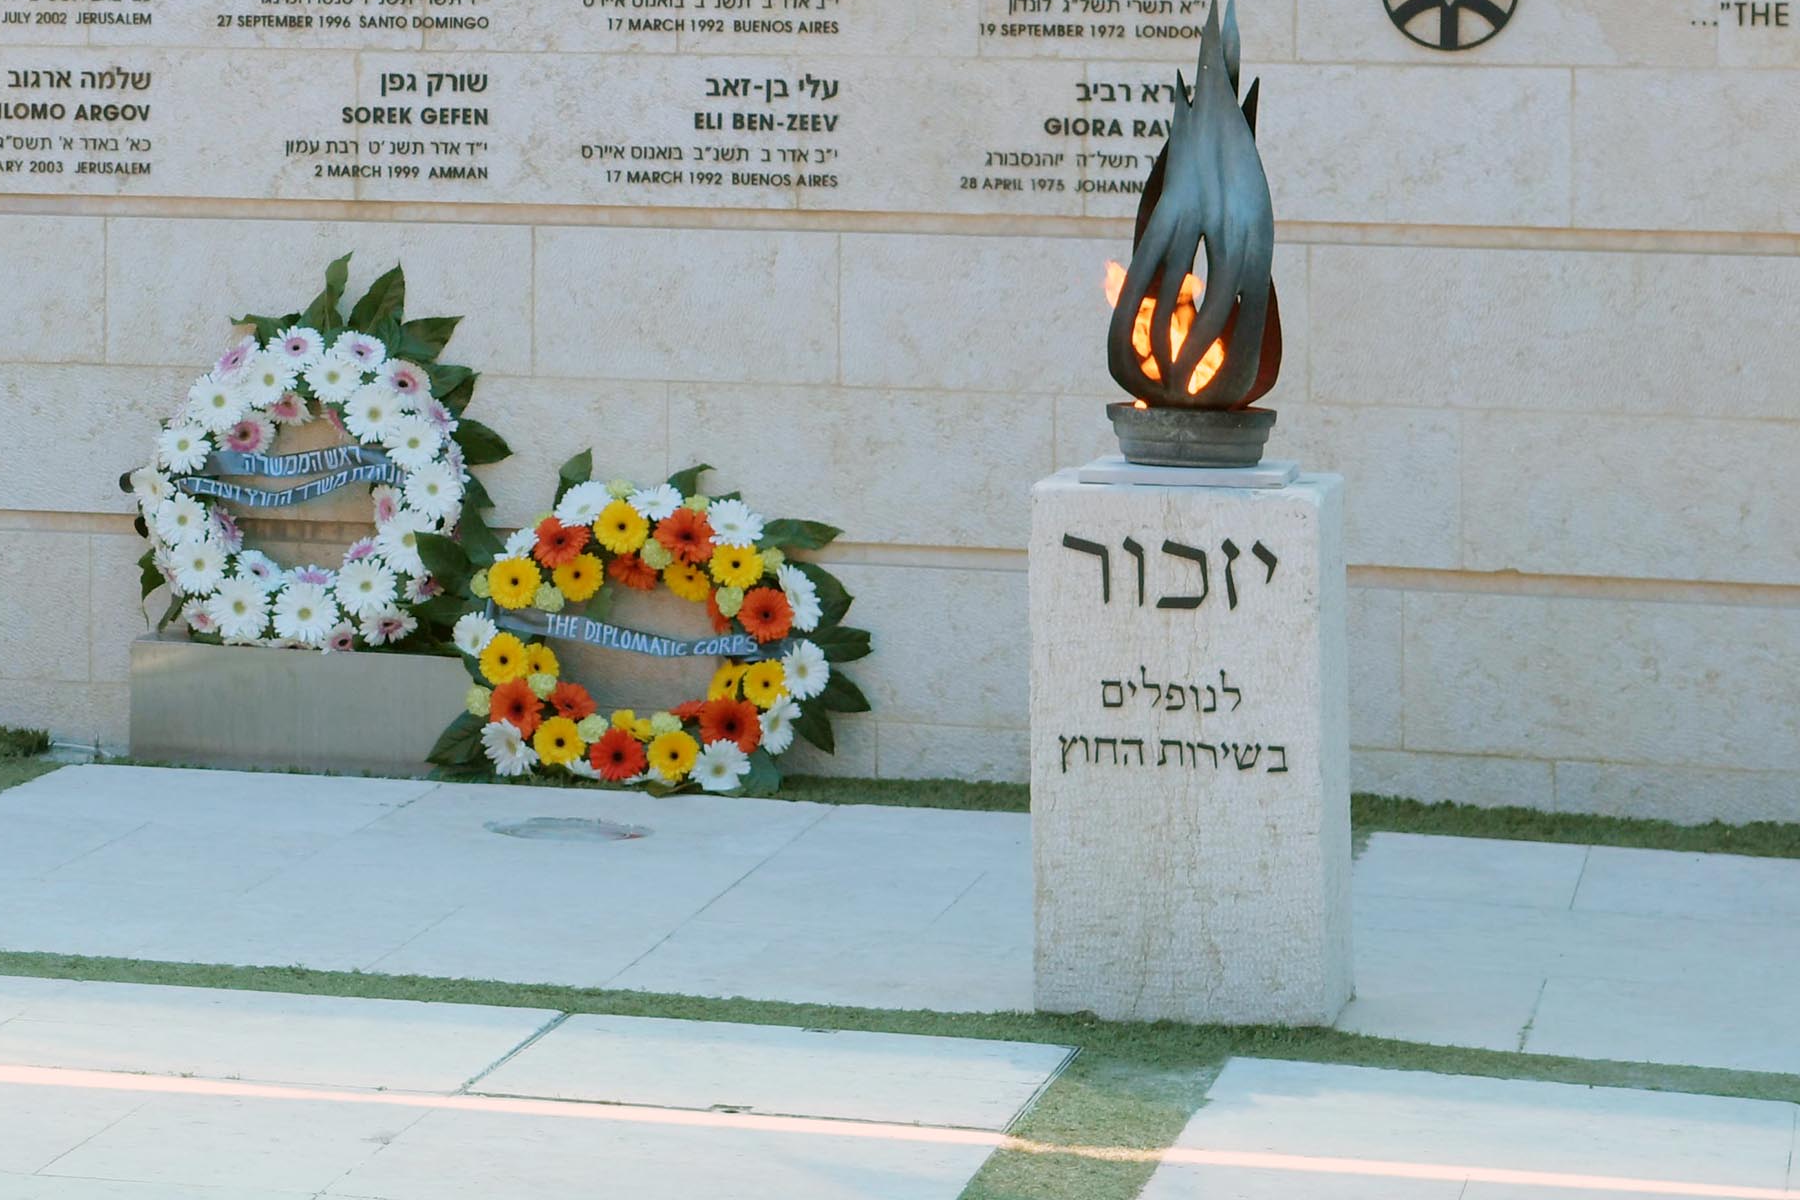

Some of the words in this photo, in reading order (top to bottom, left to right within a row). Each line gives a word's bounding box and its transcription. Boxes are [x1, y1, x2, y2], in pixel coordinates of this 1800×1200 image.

[1, 11, 32, 25] JULY
[35, 11, 68, 25] 2002
[75, 11, 153, 26] JERUSALEM
[216, 13, 233, 28] 27
[236, 14, 314, 31] SEPTEMBER
[318, 15, 352, 29] 1996
[358, 14, 408, 30] SANTO
[412, 15, 490, 33] DOMINGO
[7, 69, 73, 89] ארגוב
[80, 65, 152, 91] שלמה
[380, 72, 418, 98] גפן
[426, 72, 489, 98] שורק
[797, 72, 840, 102] עלי
[1075, 82, 1133, 104] רביב
[73, 103, 151, 123] ARGOV
[341, 106, 413, 126] SOREK
[419, 106, 489, 127] GEFEN
[693, 111, 723, 131] ELI
[732, 111, 840, 133] BEN-ZEEV
[1043, 117, 1125, 138] GIORA
[29, 160, 64, 174] 2003
[74, 161, 152, 177] JERUSALEM
[959, 176, 979, 191] 28
[981, 177, 1025, 192] APRIL
[1031, 178, 1066, 193] 1975
[241, 450, 322, 476] הממשלה
[326, 445, 362, 469] ראש
[246, 488, 294, 508] החוץ
[296, 471, 348, 501] משרד
[1062, 533, 1279, 611] יזכור
[545, 612, 579, 639] THE
[583, 619, 688, 657] DIPLOMATIC
[692, 635, 758, 656] CORPS
[1100, 665, 1243, 714] לנופלים
[1058, 734, 1145, 775] החוץ
[1156, 739, 1290, 774] בשירות
